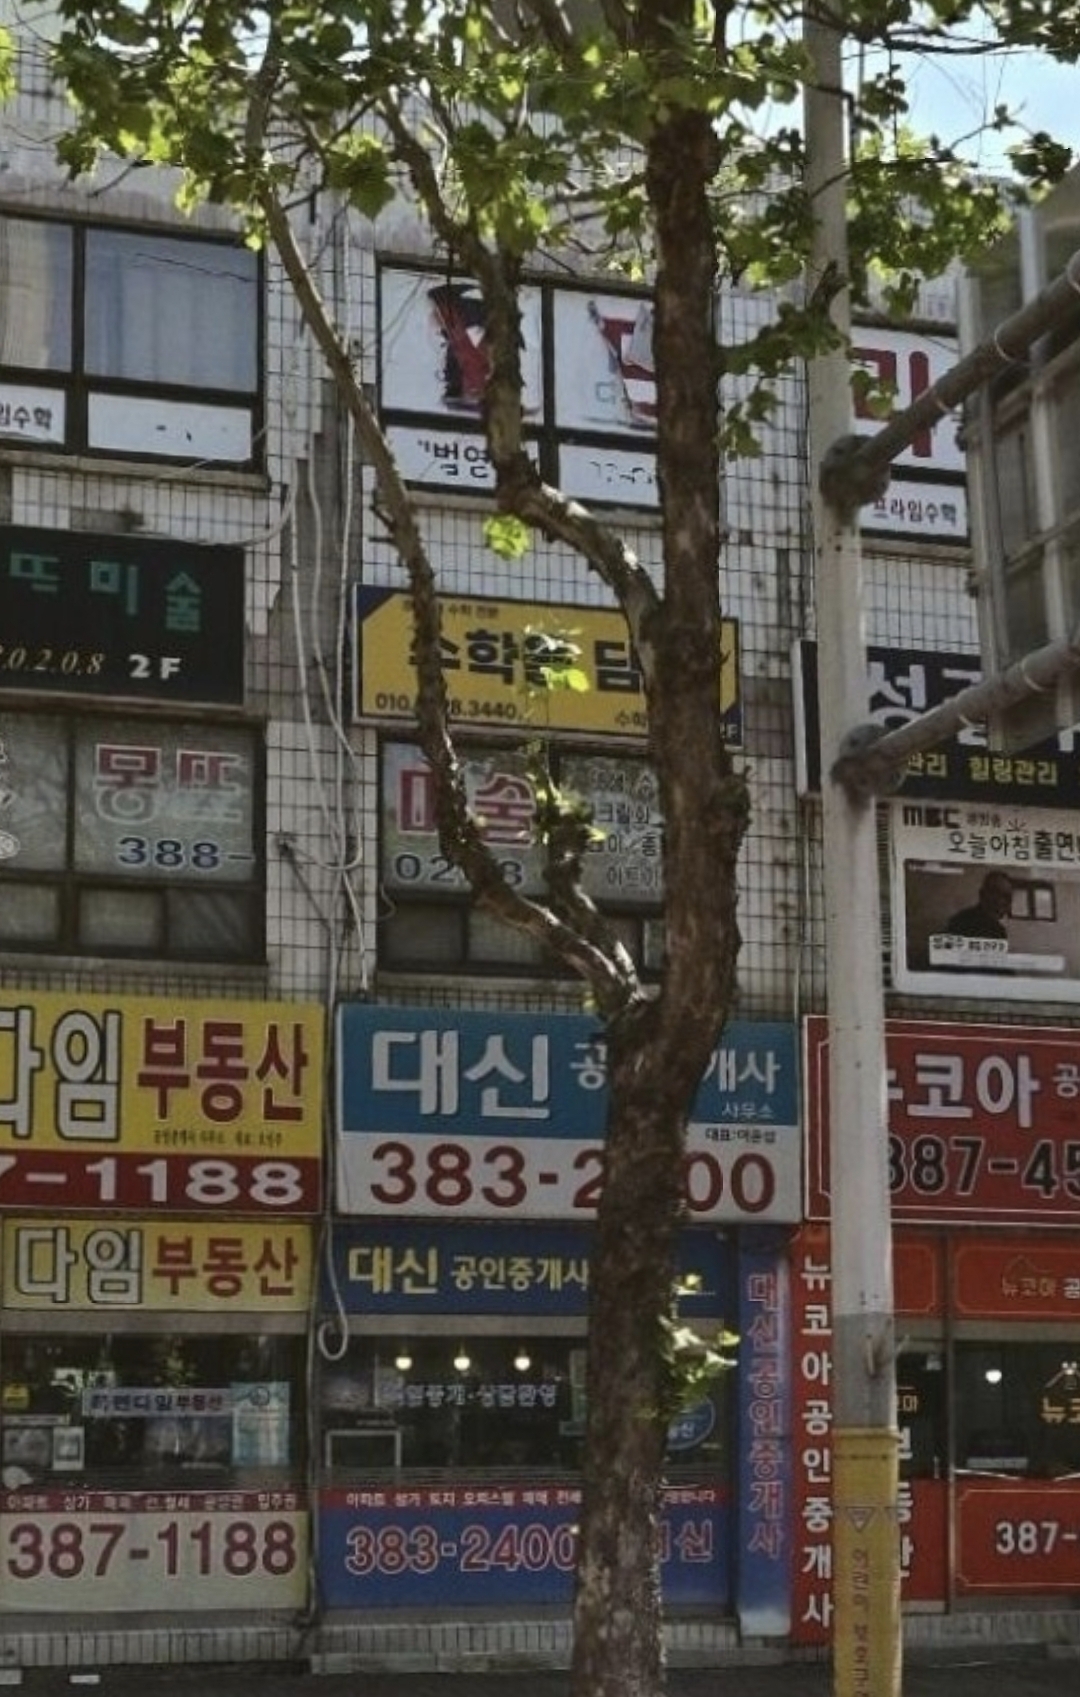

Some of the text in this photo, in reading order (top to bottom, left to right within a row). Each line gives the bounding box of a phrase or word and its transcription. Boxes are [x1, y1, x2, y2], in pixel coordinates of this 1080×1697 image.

[129, 655, 182, 680] 2F
[137, 1017, 309, 1123] 부동산
[371, 1030, 780, 1119] 대신 공개사
[370, 1141, 776, 1214] 383-200
[15, 1227, 299, 1305] 다임 부동산
[348, 1246, 590, 1295] 대신 공인중개사
[747, 1273, 785, 1559] 대신공인중개사
[800, 1254, 832, 1630] 뉴코아공인중개사
[346, 1491, 386, 1508] 아파트
[8, 1521, 297, 1579] 387-1188
[345, 1525, 580, 1575] 383-2400
